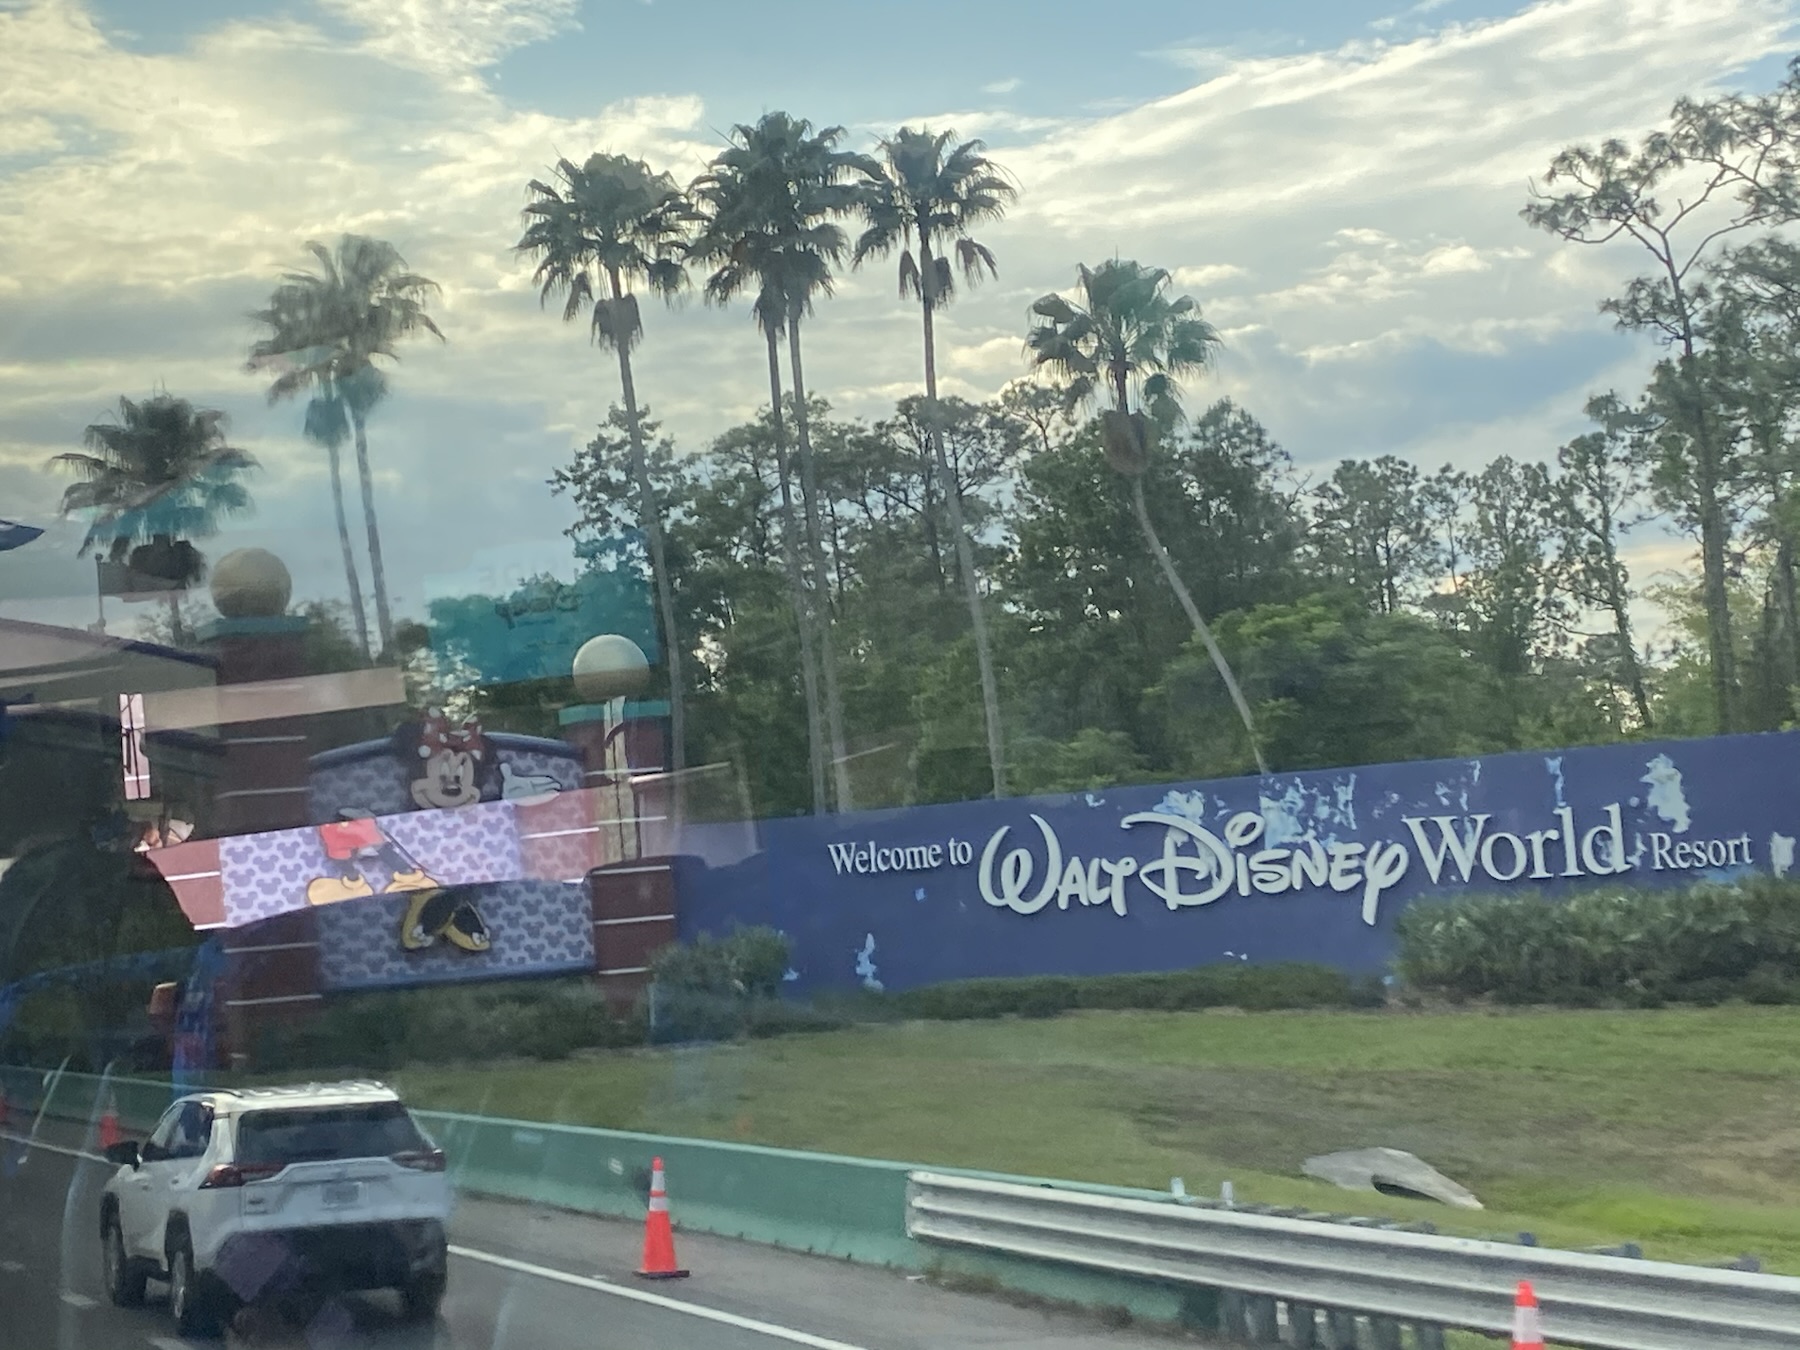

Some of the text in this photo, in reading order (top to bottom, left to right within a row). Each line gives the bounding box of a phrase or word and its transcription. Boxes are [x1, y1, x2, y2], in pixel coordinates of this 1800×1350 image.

[827, 838, 942, 875] Welcome
[948, 837, 973, 866] to
[1401, 802, 1632, 885] World
[1649, 832, 1753, 871] Resort
